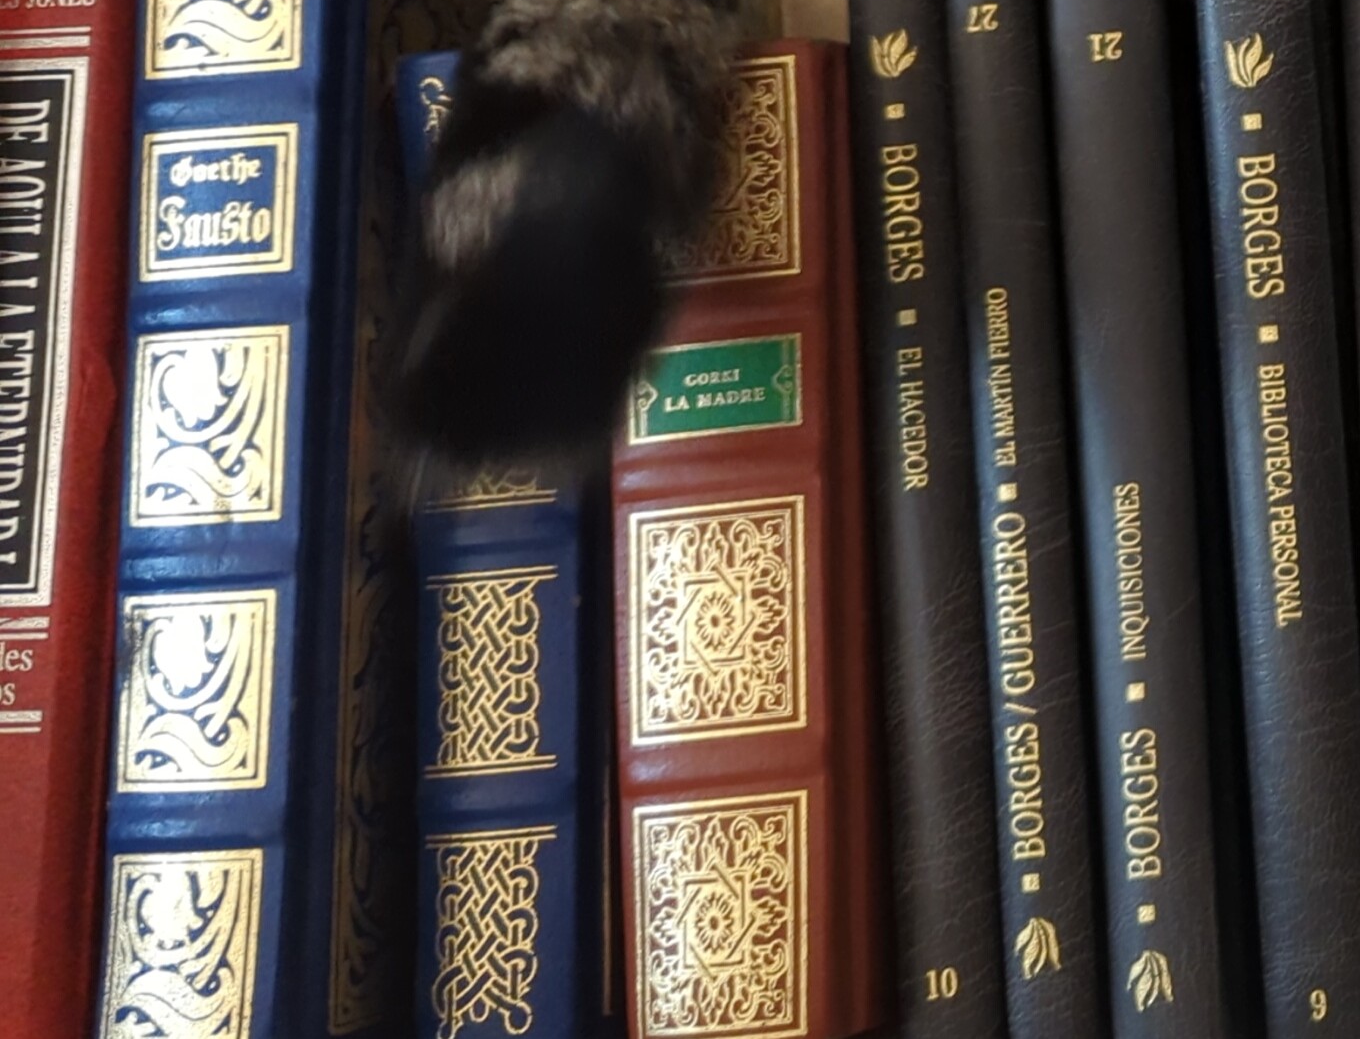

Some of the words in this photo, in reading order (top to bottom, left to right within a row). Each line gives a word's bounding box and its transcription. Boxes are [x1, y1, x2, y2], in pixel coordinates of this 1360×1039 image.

[966, 3, 999, 33] 27
[1089, 31, 1123, 62] 21
[170, 153, 261, 186] Goethe
[157, 195, 272, 251] Fausto
[881, 144, 925, 280] BORGES
[1237, 153, 1285, 299] BORGES
[987, 287, 1010, 360] FIERRO
[684, 368, 740, 386] GORKI
[897, 346, 923, 375] EL
[664, 395, 690, 412] LA
[697, 387, 766, 408] MADRE
[900, 380, 929, 492] HACEDOR
[986, 364, 1016, 438] MARTÍN
[1258, 363, 1293, 502] BIBLIOTECA
[996, 440, 1017, 467] EL
[1113, 482, 1150, 661] INQUISICIONES
[1268, 504, 1303, 627] PERSONAL
[996, 512, 1036, 696] GUERRERO
[1009, 722, 1046, 861] BORGES
[1124, 728, 1162, 879] BORGES
[926, 967, 958, 1001] 10
[1309, 989, 1327, 1021] 9
